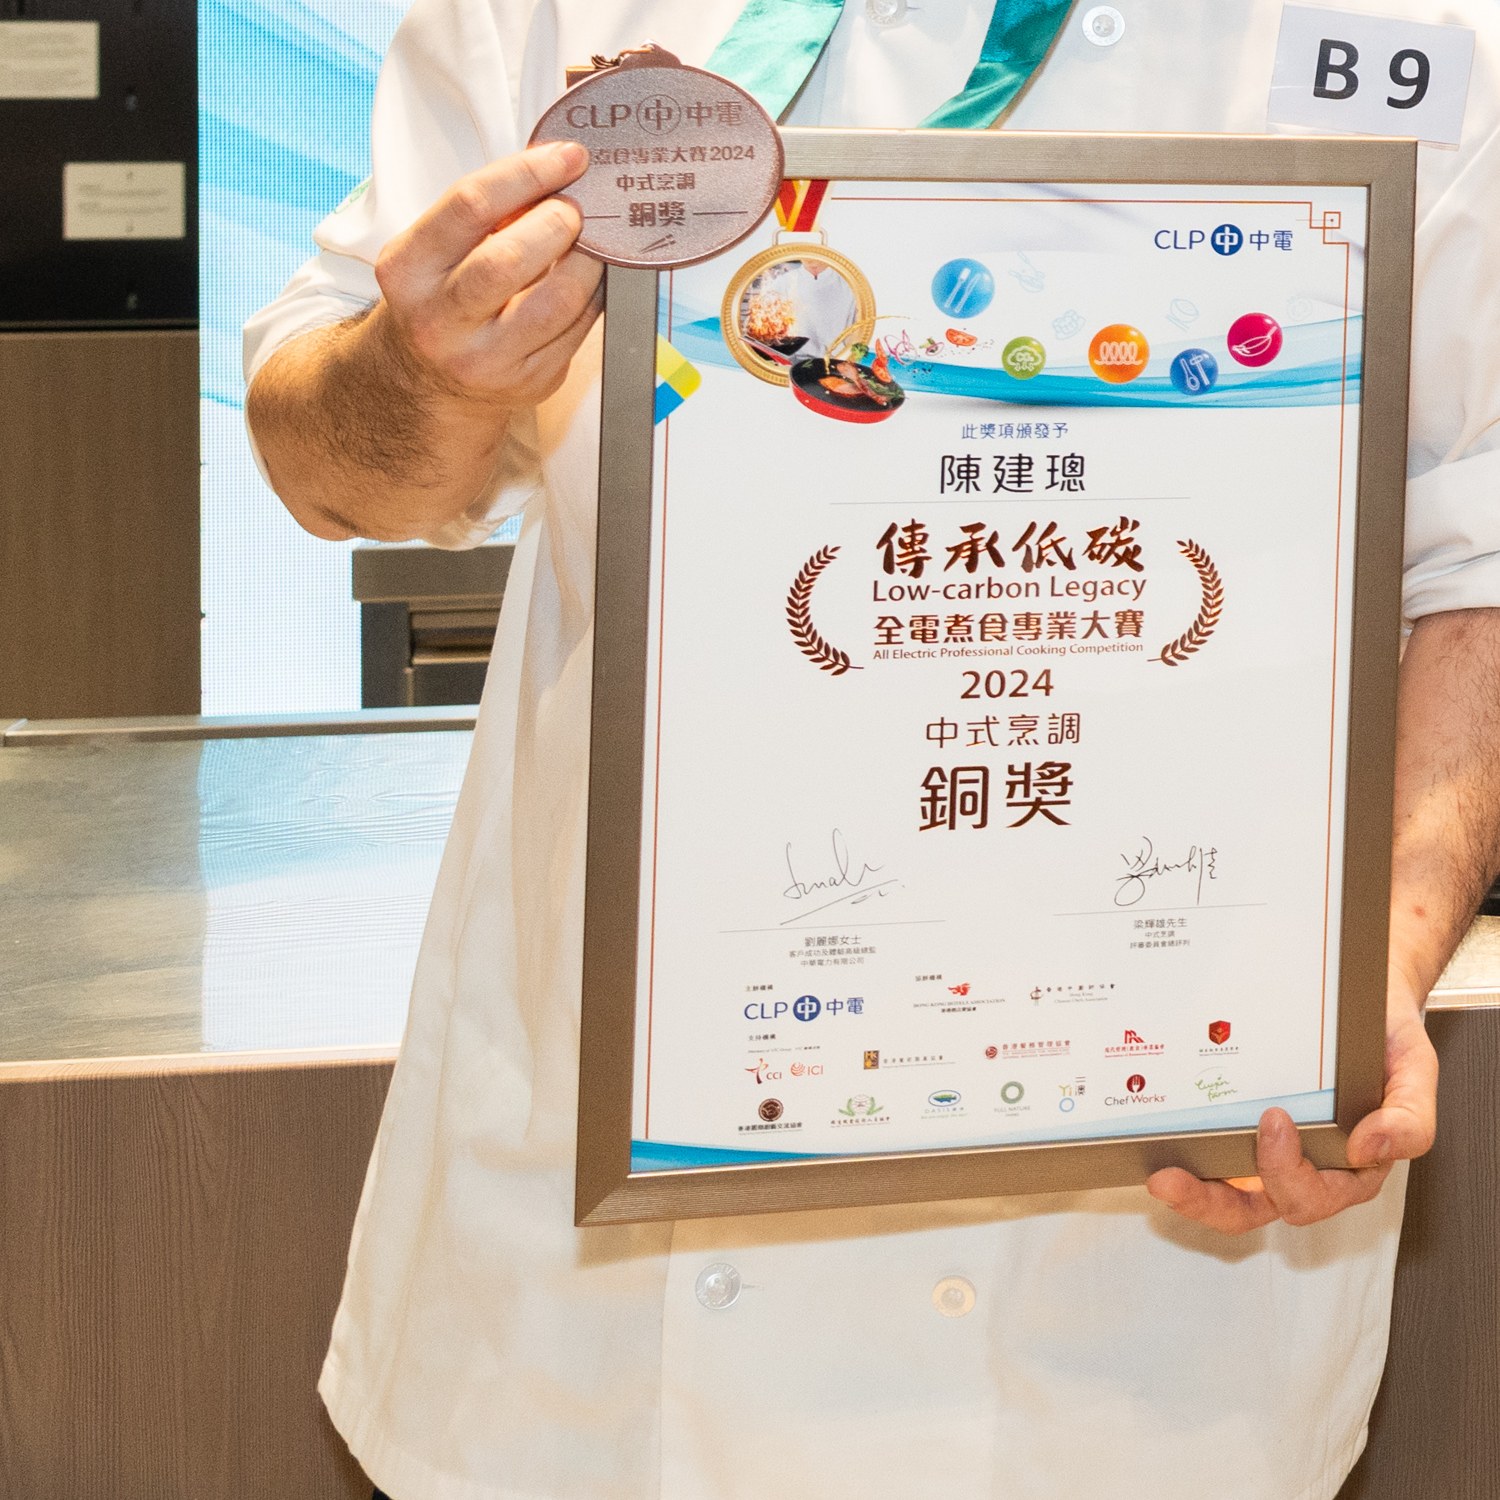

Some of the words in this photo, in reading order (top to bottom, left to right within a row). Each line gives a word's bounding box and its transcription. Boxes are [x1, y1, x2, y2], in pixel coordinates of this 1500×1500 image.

[1313, 39, 1359, 100] B
[1386, 49, 1431, 109] 9
[566, 104, 631, 128] CLP
[687, 101, 743, 127] 中電
[617, 173, 695, 191] 中式烹調
[629, 202, 685, 228] 銅獎
[1154, 230, 1205, 251] CLP
[1249, 230, 1293, 251] 中電
[961, 422, 1069, 440] 此獎項頒發予
[875, 515, 1146, 579] 傳承低碳
[873, 576, 1040, 602] Low-carbon
[1050, 575, 1147, 601] Legacy
[873, 609, 1145, 646] 全電煮食專業大賽
[873, 648, 889, 660] All
[892, 647, 937, 659] Electric
[940, 645, 1014, 658] Professional
[1017, 644, 1067, 658] Cooking
[1070, 642, 1144, 657] Competition
[960, 668, 1054, 699] 2024
[926, 712, 1081, 749] 中式烹調
[919, 761, 1074, 832] 銅獎
[744, 1001, 788, 1020] CLP
[826, 997, 864, 1016] 中電
[766, 1071, 783, 1080] CCI
[807, 1065, 824, 1076] ICI
